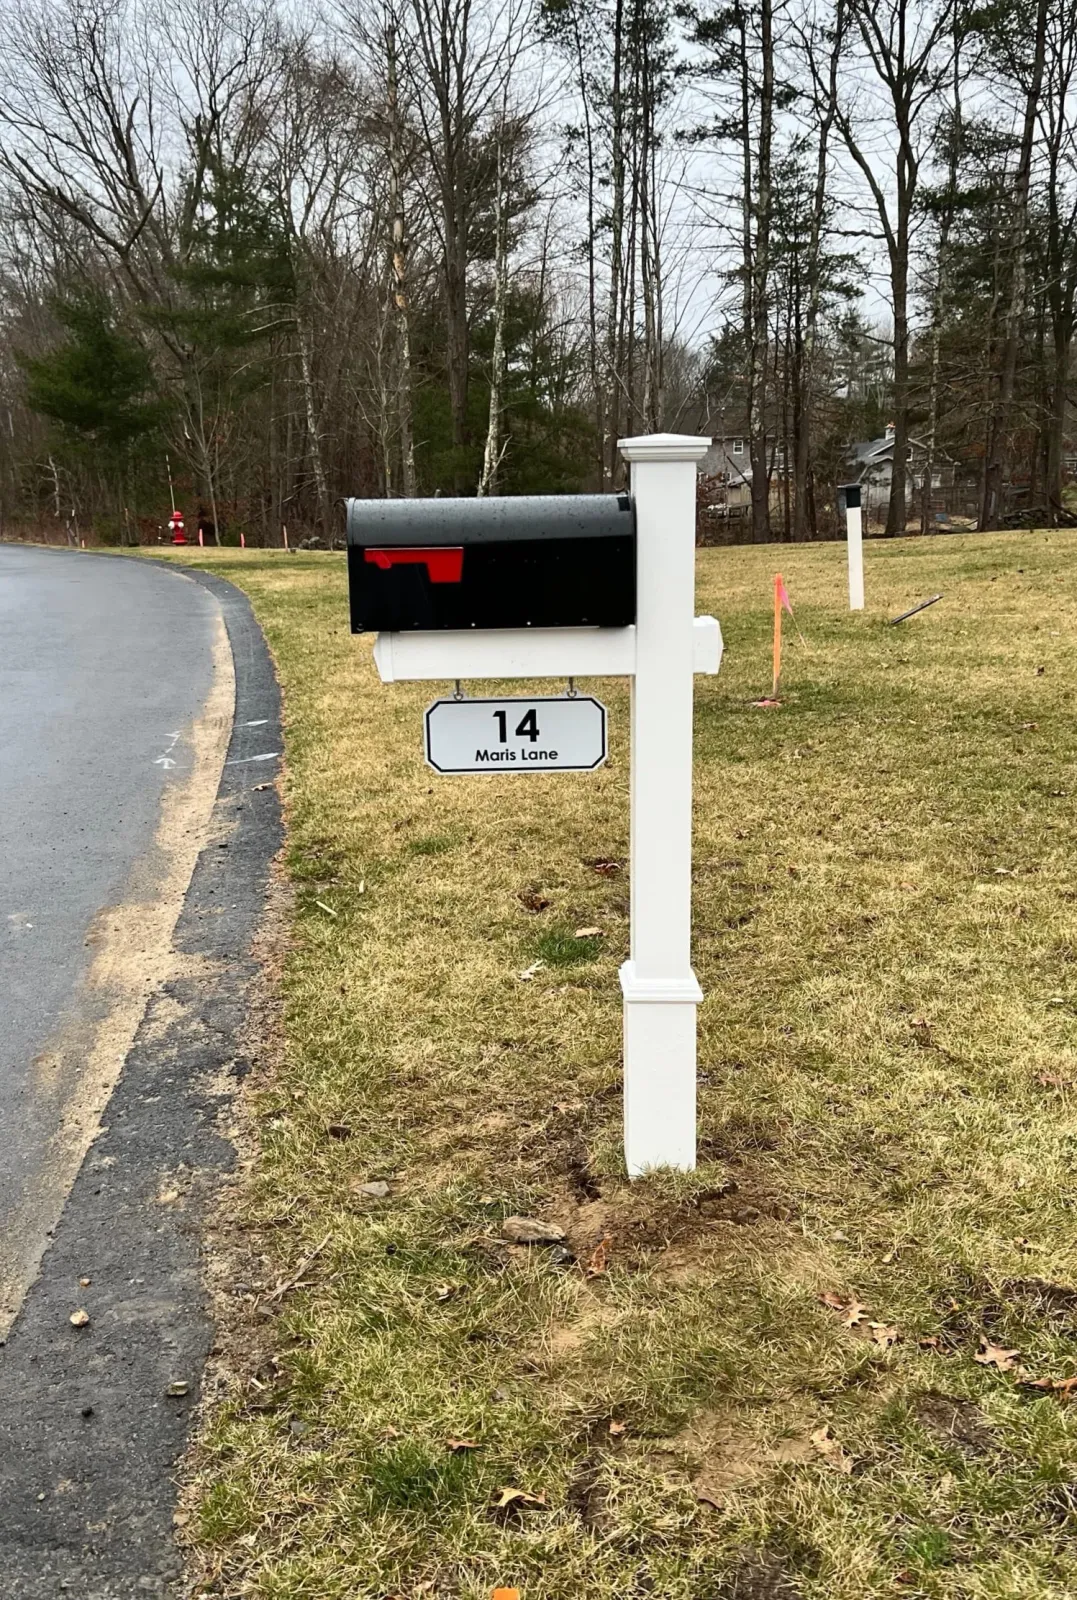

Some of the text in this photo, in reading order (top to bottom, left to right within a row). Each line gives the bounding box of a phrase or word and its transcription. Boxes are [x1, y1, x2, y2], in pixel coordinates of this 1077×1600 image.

[493, 709, 540, 743] 14
[475, 748, 559, 762] Maris Lane
